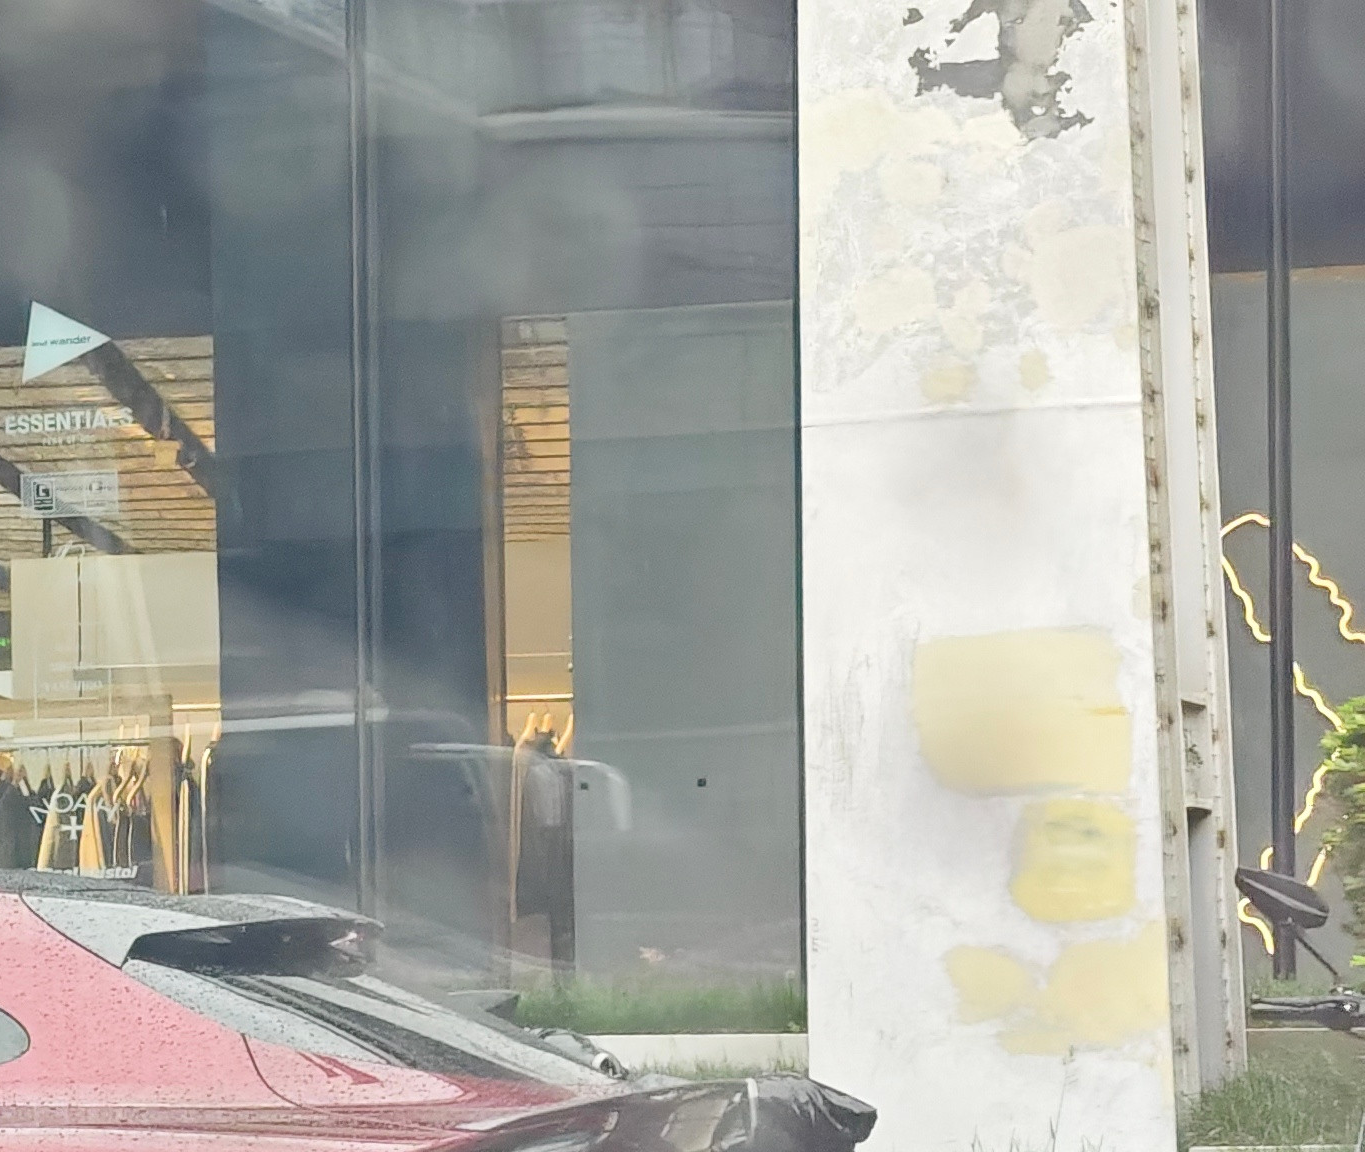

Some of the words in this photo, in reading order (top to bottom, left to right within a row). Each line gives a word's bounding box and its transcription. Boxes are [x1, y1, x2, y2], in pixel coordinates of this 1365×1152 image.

[50, 334, 91, 346] wander
[5, 407, 135, 435] ESSENTIALS
[30, 793, 121, 824] NOAH
